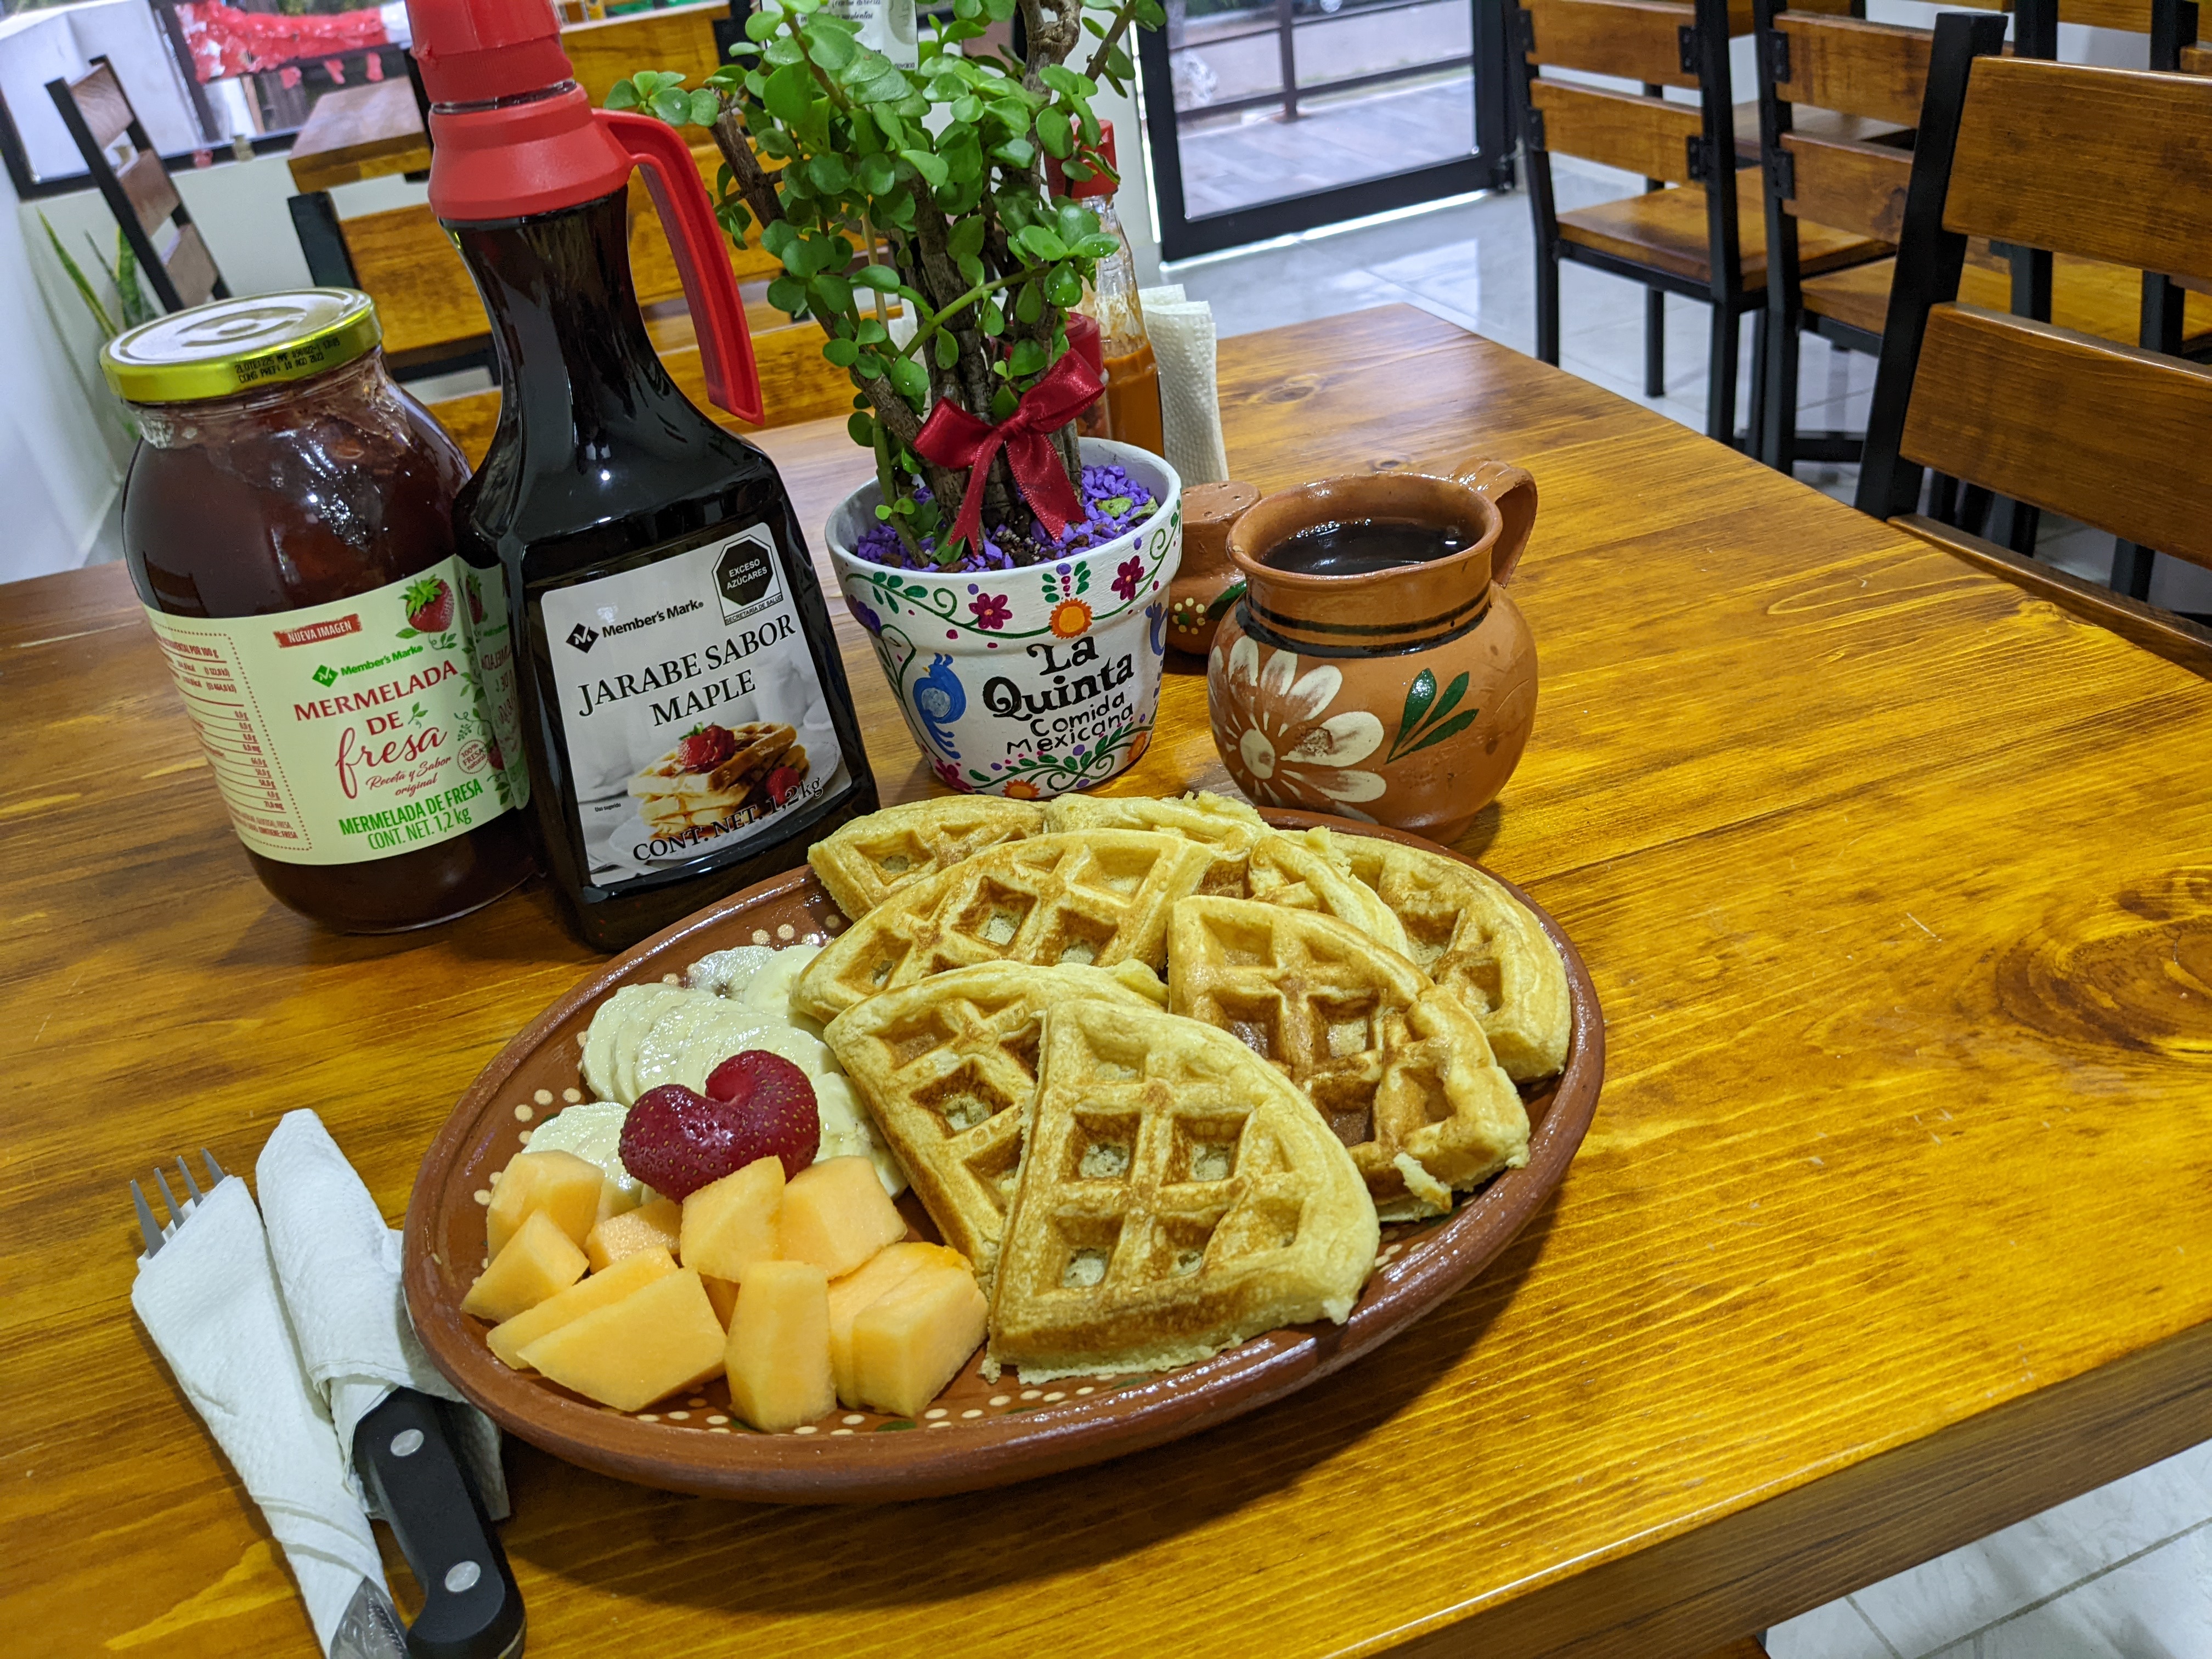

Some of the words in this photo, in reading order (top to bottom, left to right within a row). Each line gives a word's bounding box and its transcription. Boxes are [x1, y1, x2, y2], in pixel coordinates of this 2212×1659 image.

[726, 566, 768, 590] AZÚCARES
[729, 558, 760, 578] EXCESO
[602, 611, 665, 638] Member's
[725, 606, 759, 624] SECRETARÍA
[766, 595, 783, 607] SALUD
[287, 628, 317, 643] NUEVA
[317, 621, 353, 637] IMAGEN
[340, 654, 391, 676] Member's
[578, 652, 702, 717] JARABE
[704, 614, 797, 670] SABOR
[1026, 636, 1099, 675] La
[294, 660, 459, 721] MERMELADA
[649, 669, 757, 727] MAPLE
[982, 653, 1135, 721] Quinta
[366, 711, 404, 736] DE
[1007, 703, 1133, 755] Mexicana
[1030, 691, 1125, 737] Comida
[335, 727, 448, 799] fresa
[366, 770, 406, 791] Receta
[410, 769, 416, 778] y
[416, 756, 452, 777] Sabor
[463, 749, 483, 766] FRESA
[467, 754, 486, 770] natural
[395, 772, 438, 797] original
[338, 802, 427, 836] MERMELADA
[425, 794, 445, 815] DE
[445, 778, 484, 808] FRESA
[633, 827, 708, 861] CONT.
[713, 805, 762, 838] NET.
[768, 786, 799, 818] 1,2
[800, 777, 824, 799] kg
[368, 827, 406, 850] CONT.
[405, 819, 435, 841] NET.
[434, 811, 454, 833] 1,2
[453, 807, 472, 825] kg
